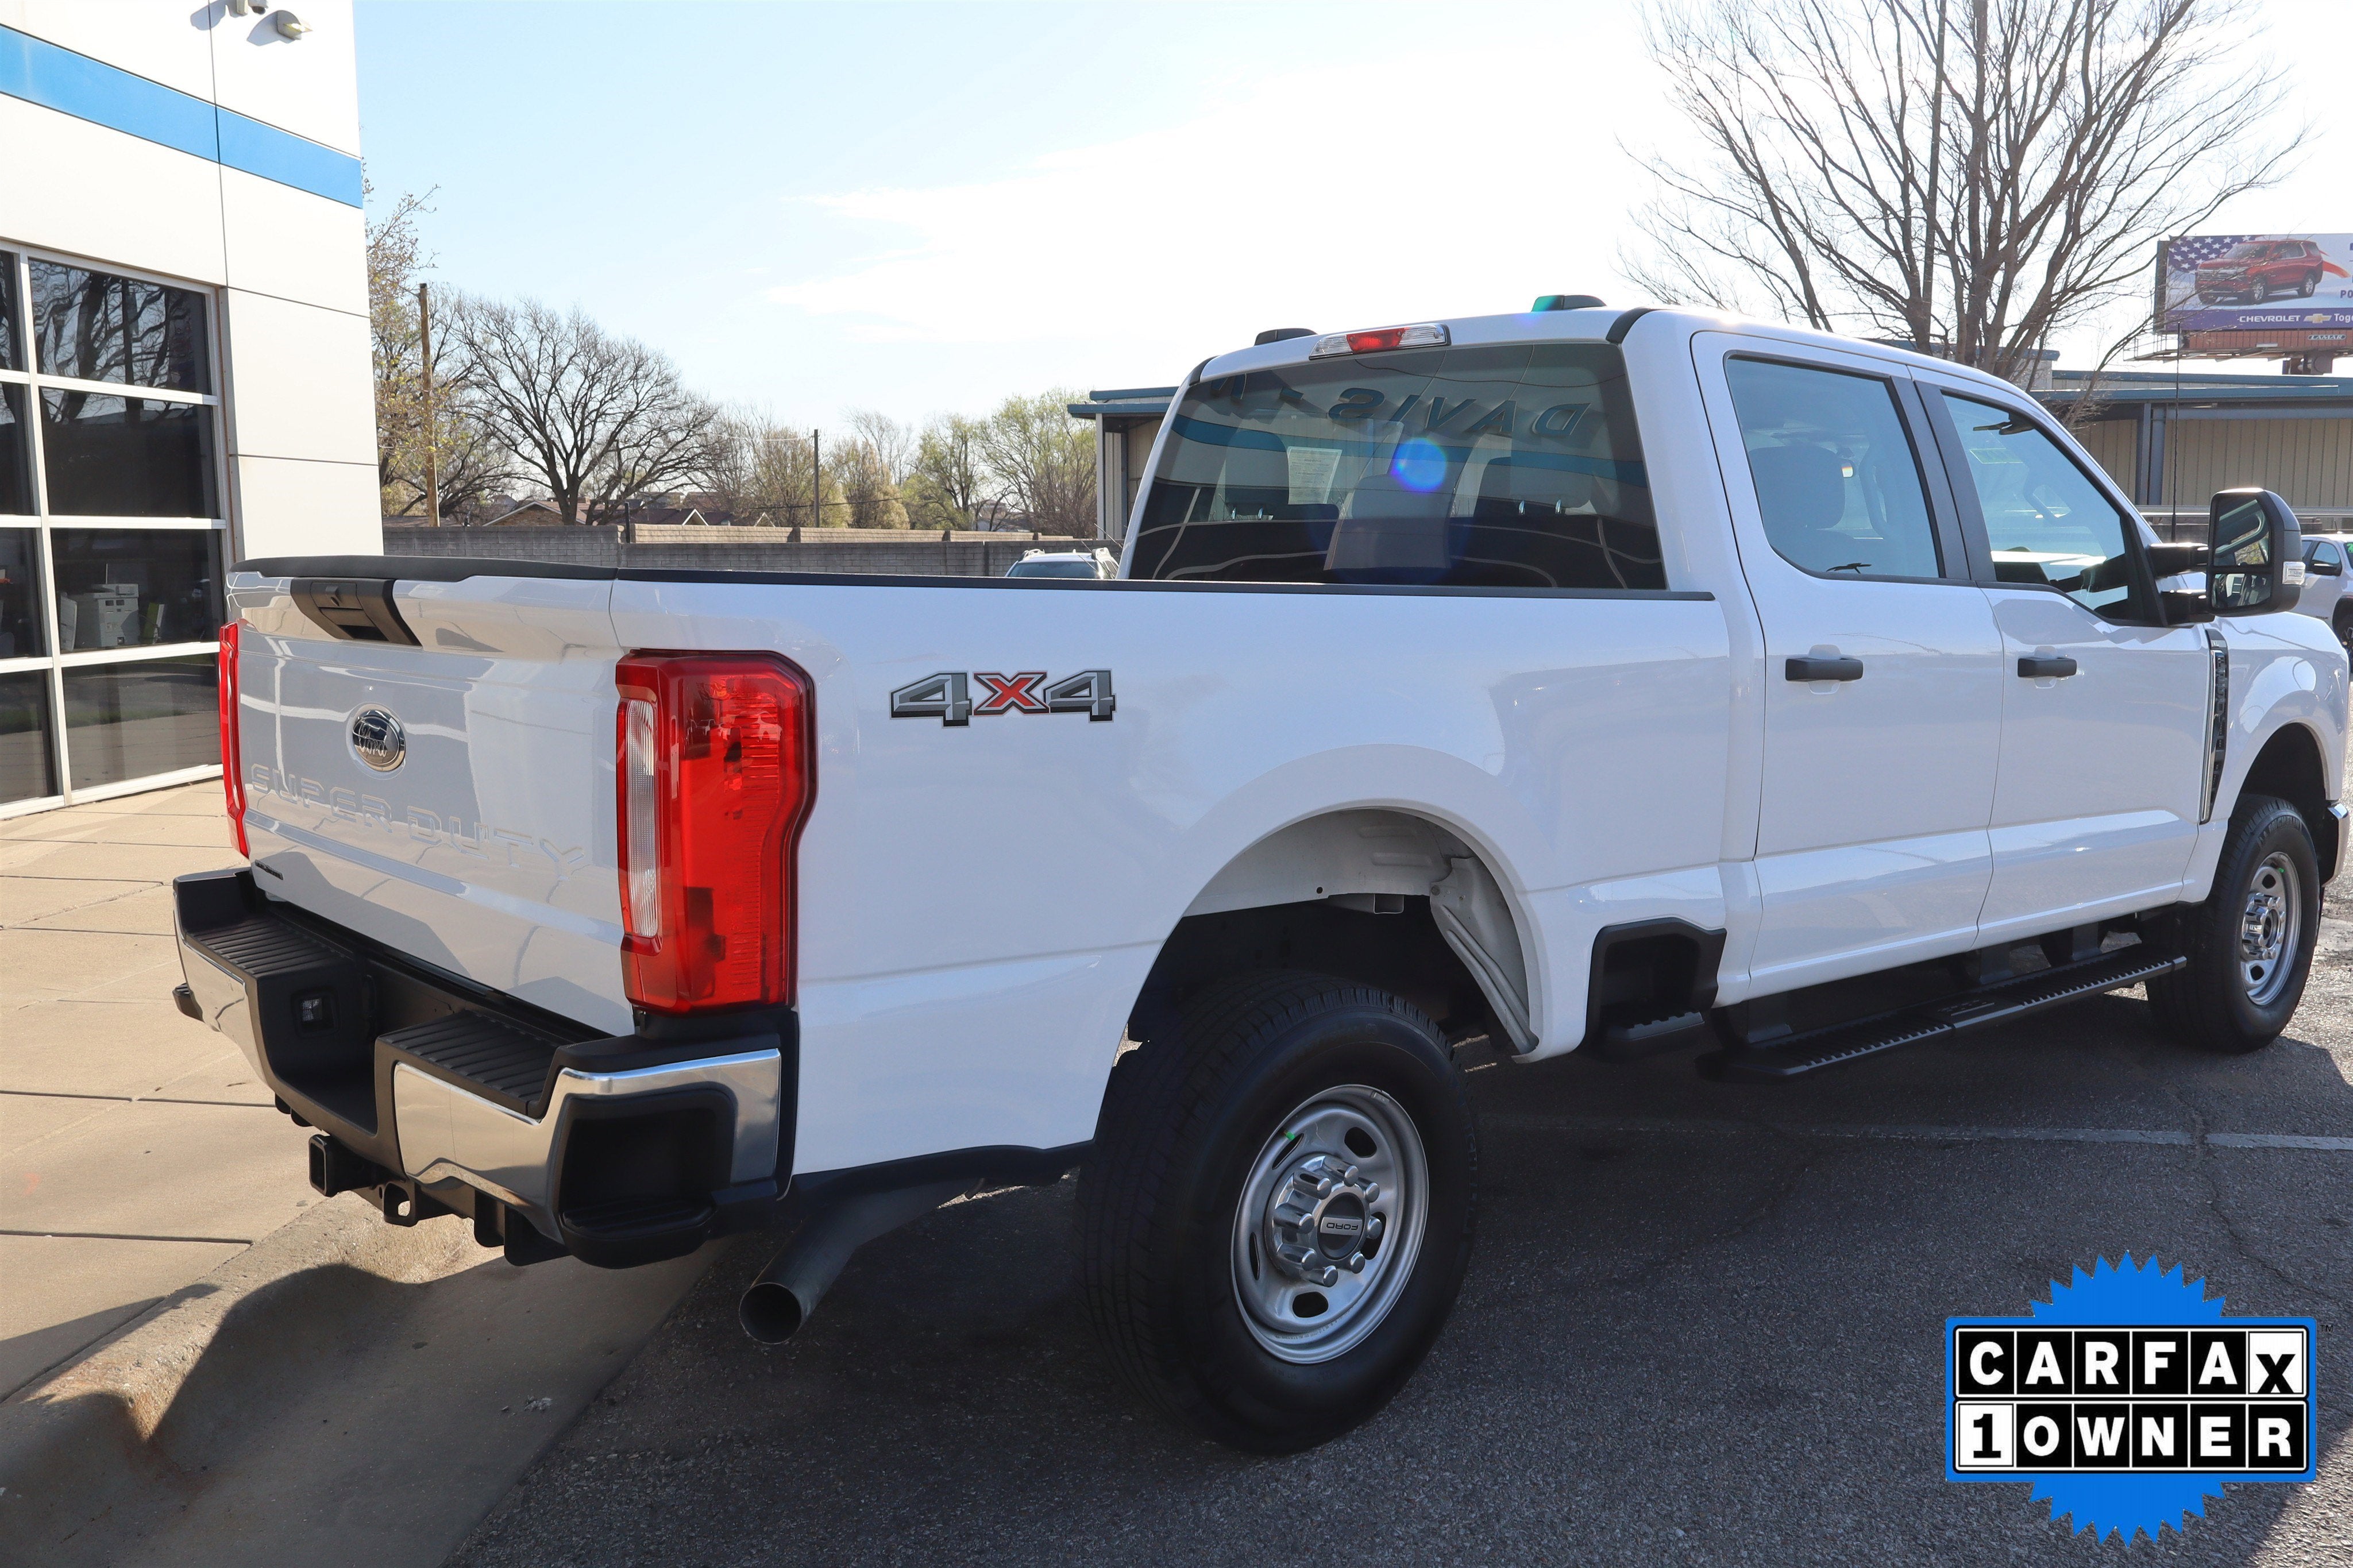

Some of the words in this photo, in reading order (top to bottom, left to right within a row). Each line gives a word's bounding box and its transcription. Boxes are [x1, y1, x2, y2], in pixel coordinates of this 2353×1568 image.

[352, 720, 388, 757] Ford
[250, 763, 392, 833] SUPER
[407, 805, 585, 881] DUTY
[1326, 1222, 1359, 1230] FORD
